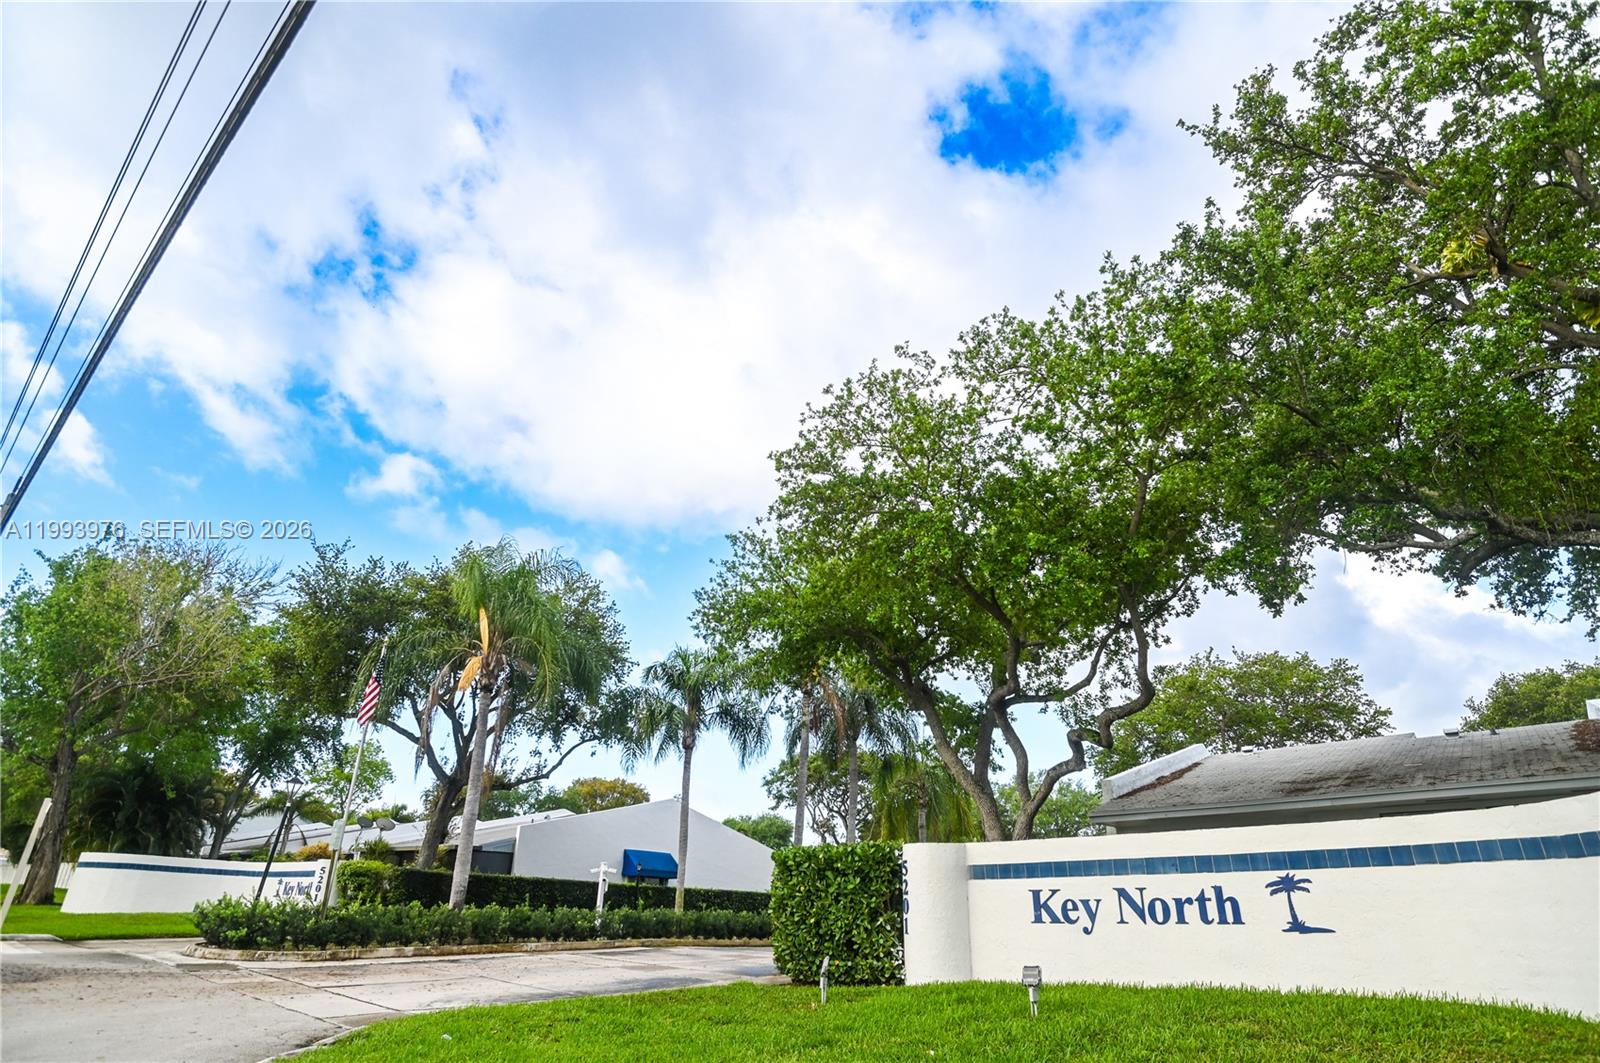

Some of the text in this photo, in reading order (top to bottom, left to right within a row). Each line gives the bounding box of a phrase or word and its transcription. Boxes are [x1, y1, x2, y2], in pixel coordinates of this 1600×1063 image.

[314, 866, 327, 902] 5201
[1028, 885, 1246, 936] Key North
